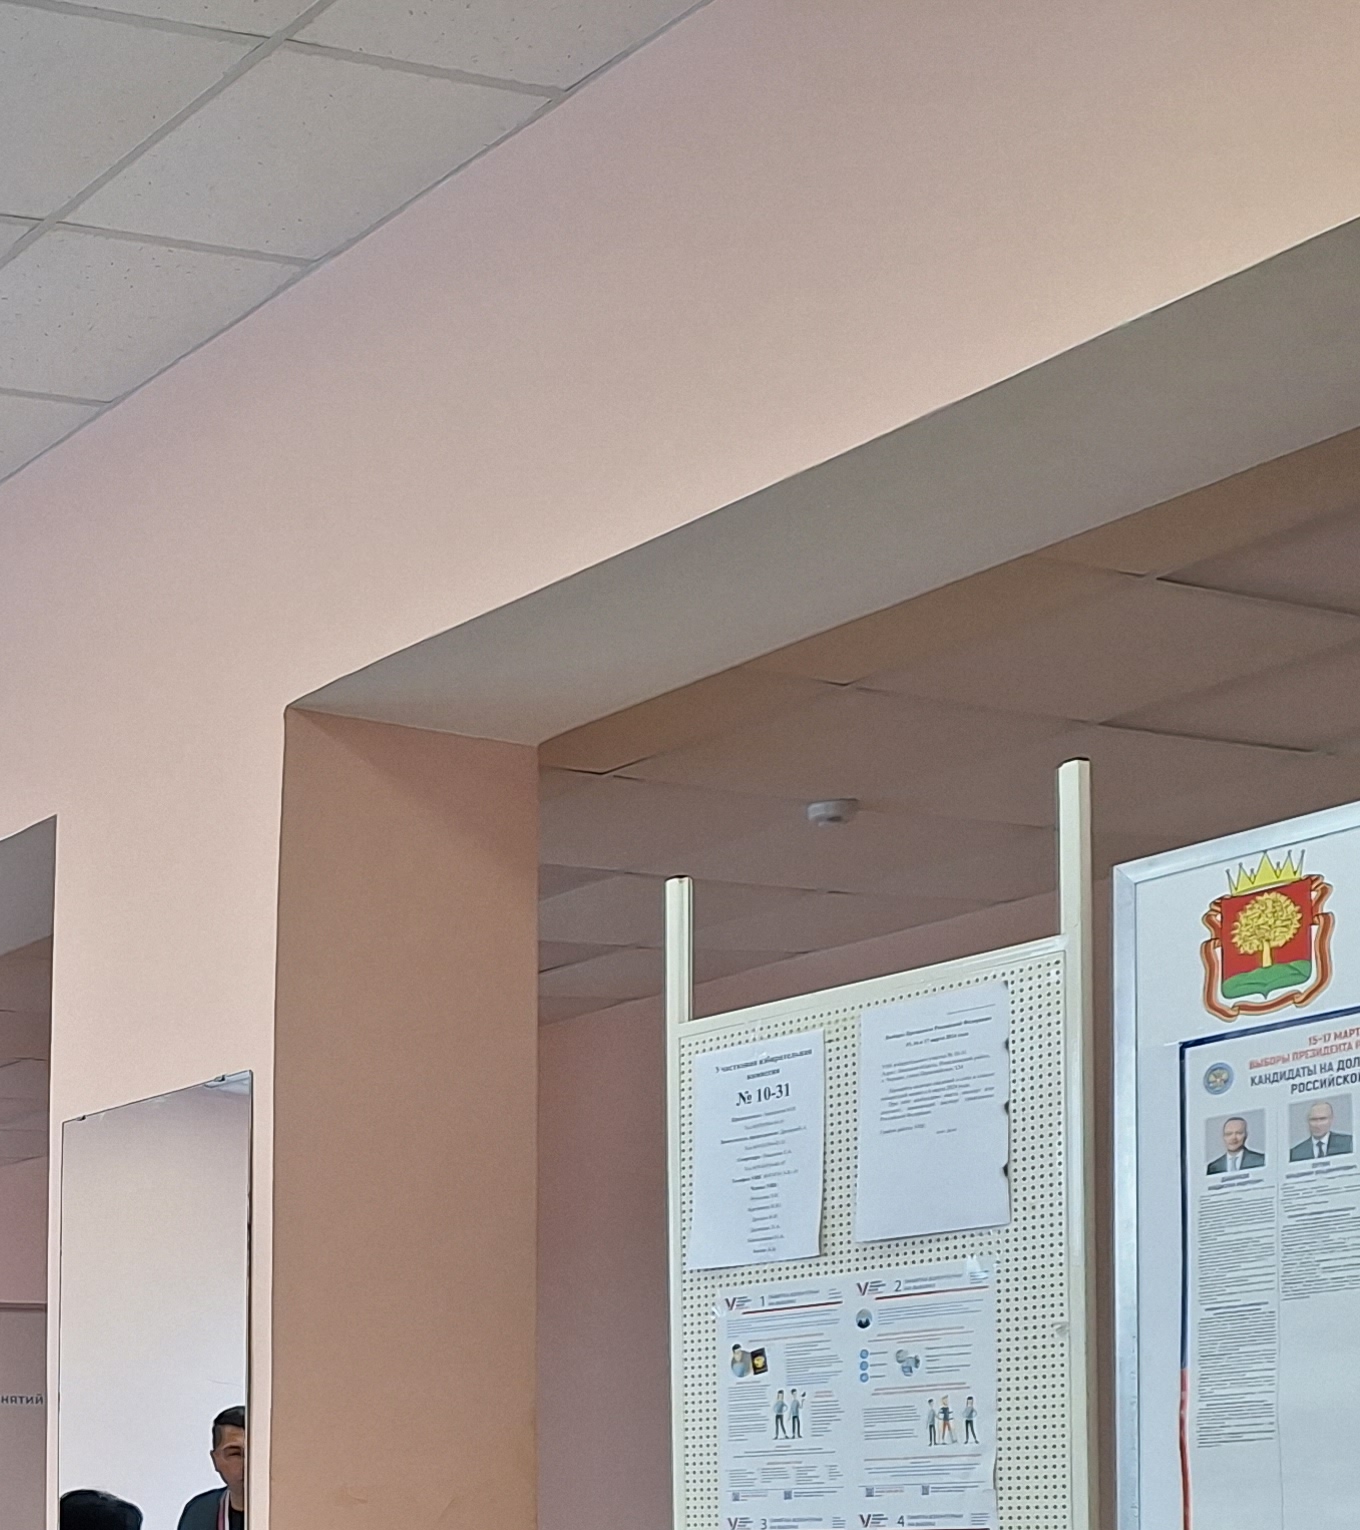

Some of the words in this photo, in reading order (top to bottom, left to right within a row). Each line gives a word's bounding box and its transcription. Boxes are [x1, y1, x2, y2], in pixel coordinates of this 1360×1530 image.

[1249, 1053, 1290, 1070] ВЫБОРЫ
[1292, 1042, 1353, 1061] ПРЕЗИДЕНТА
[1250, 1064, 1317, 1087] КАНДИДАТЫ
[1320, 1061, 1334, 1074] НА
[736, 1090, 752, 1106] №
[757, 1083, 790, 1102] 10-31
